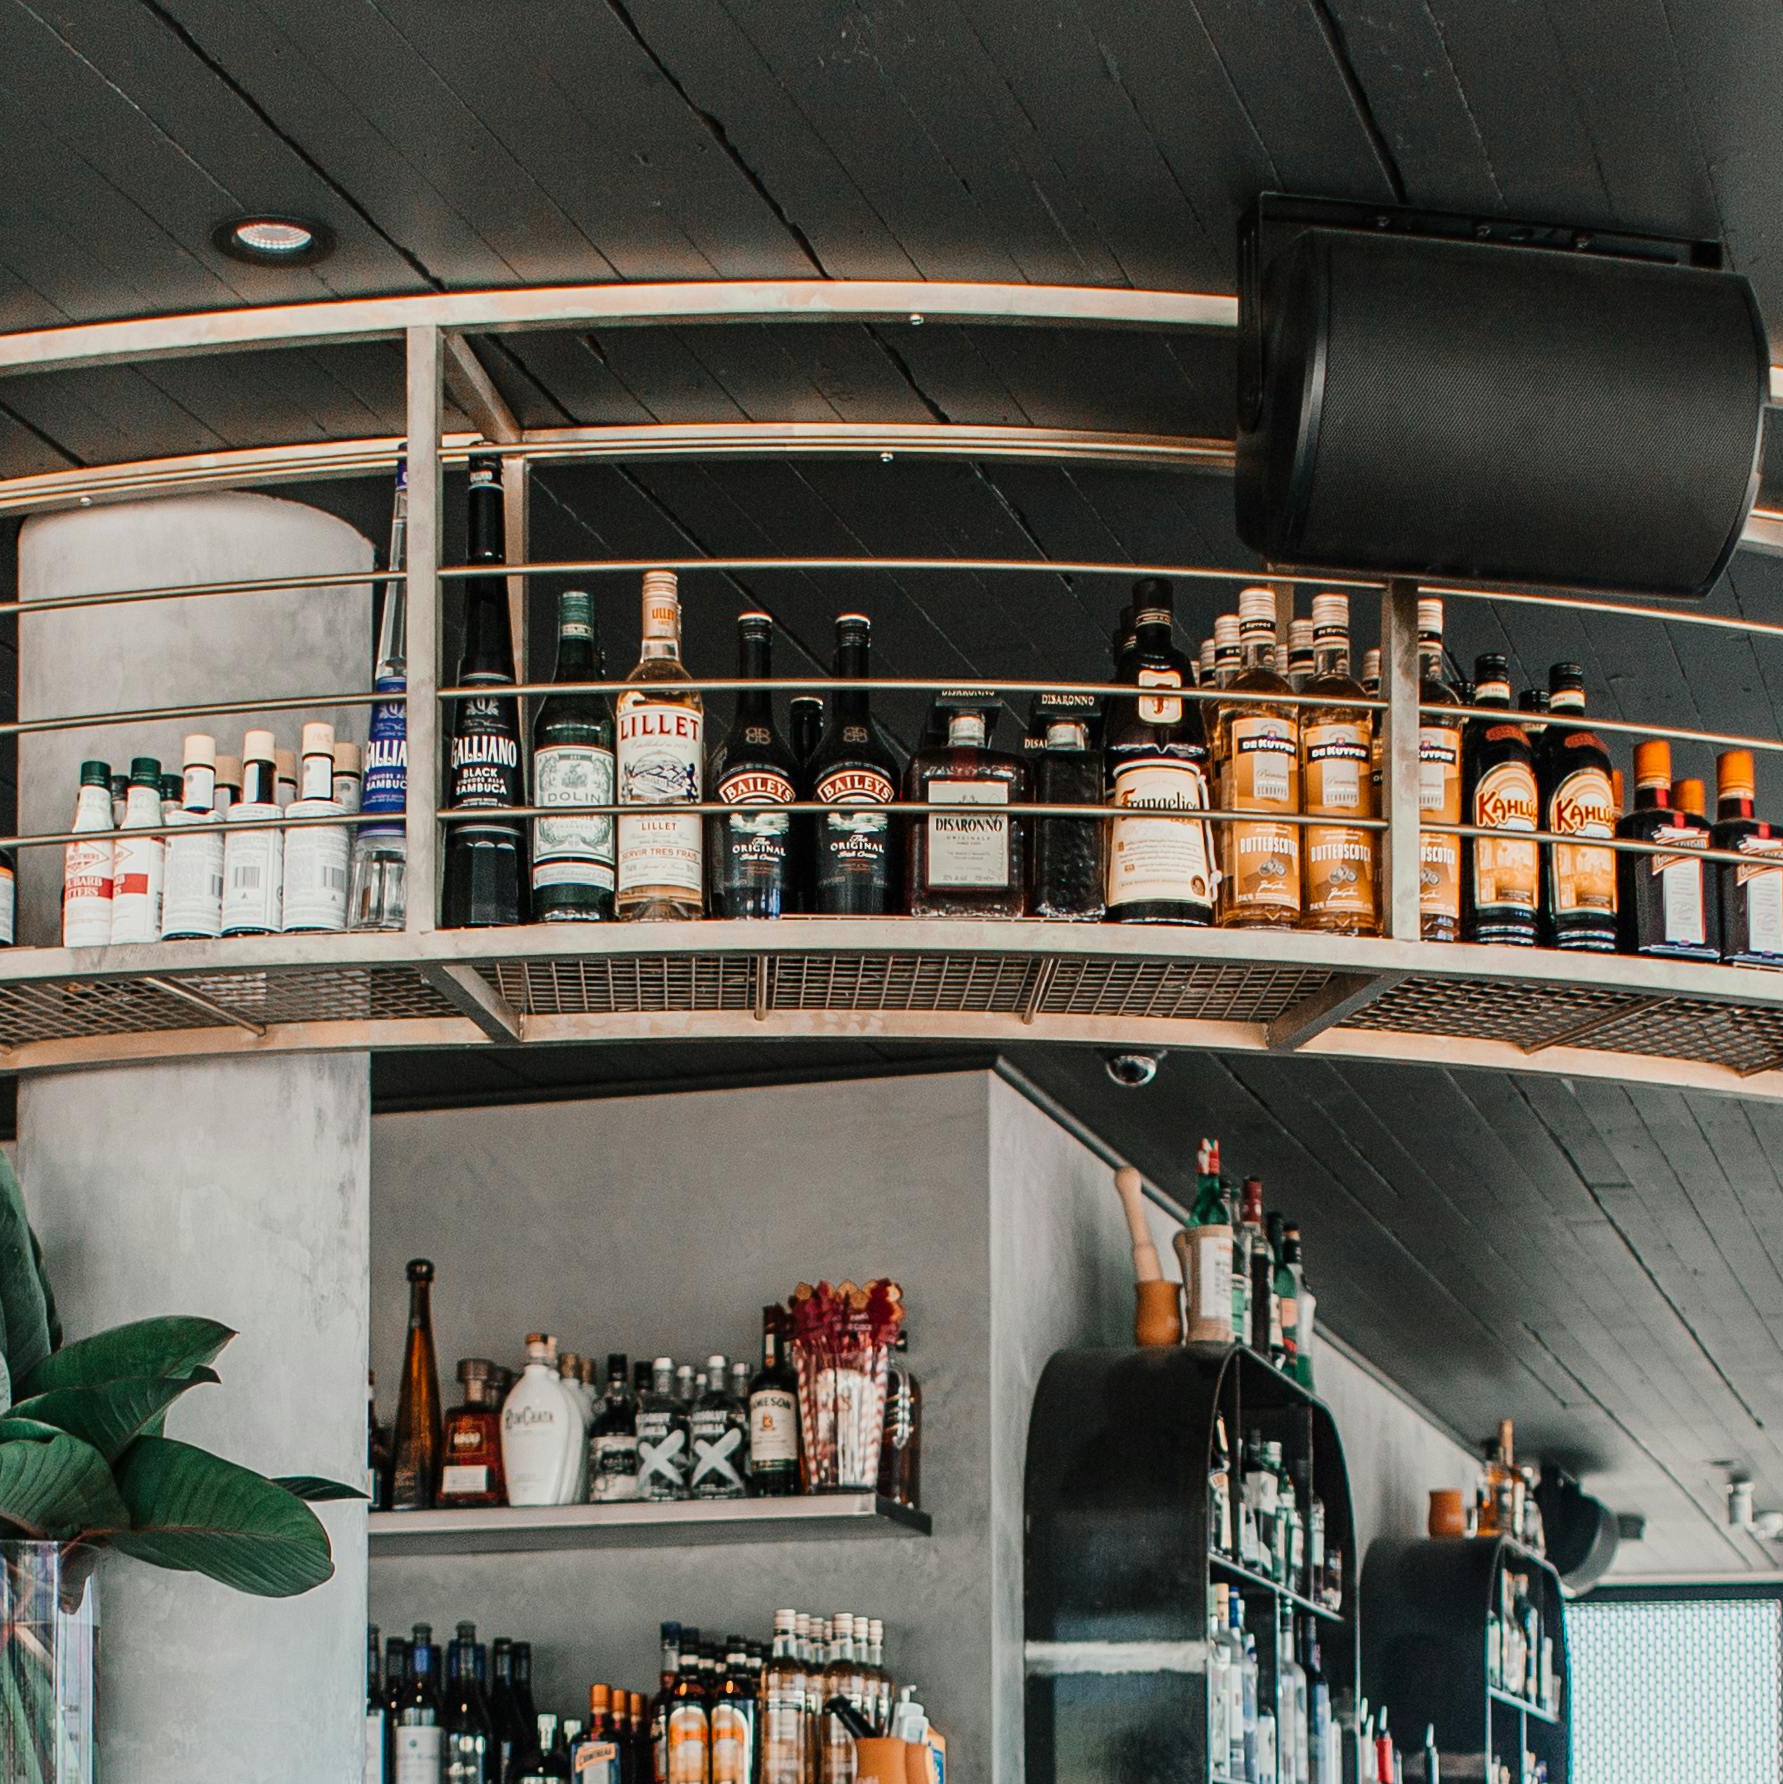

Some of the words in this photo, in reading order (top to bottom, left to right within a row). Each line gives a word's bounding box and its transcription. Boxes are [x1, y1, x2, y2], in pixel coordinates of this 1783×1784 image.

[1042, 694, 1095, 706] DISARONNO
[620, 714, 699, 741] LILLET
[1024, 738, 1047, 749] DISA
[451, 735, 516, 769] GALLIANO
[463, 768, 497, 778] BLACK
[367, 779, 406, 792] SAMBUC
[456, 783, 507, 796] SAMBUCA
[726, 777, 793, 801] BAILEYS
[824, 775, 891, 801] BAILEYS
[548, 792, 600, 804] DOLIN
[641, 823, 677, 831] LILLET
[935, 815, 1003, 832] DISARONNO
[732, 843, 786, 857] ORIGINAL
[830, 841, 884, 854] ORIGINAL
